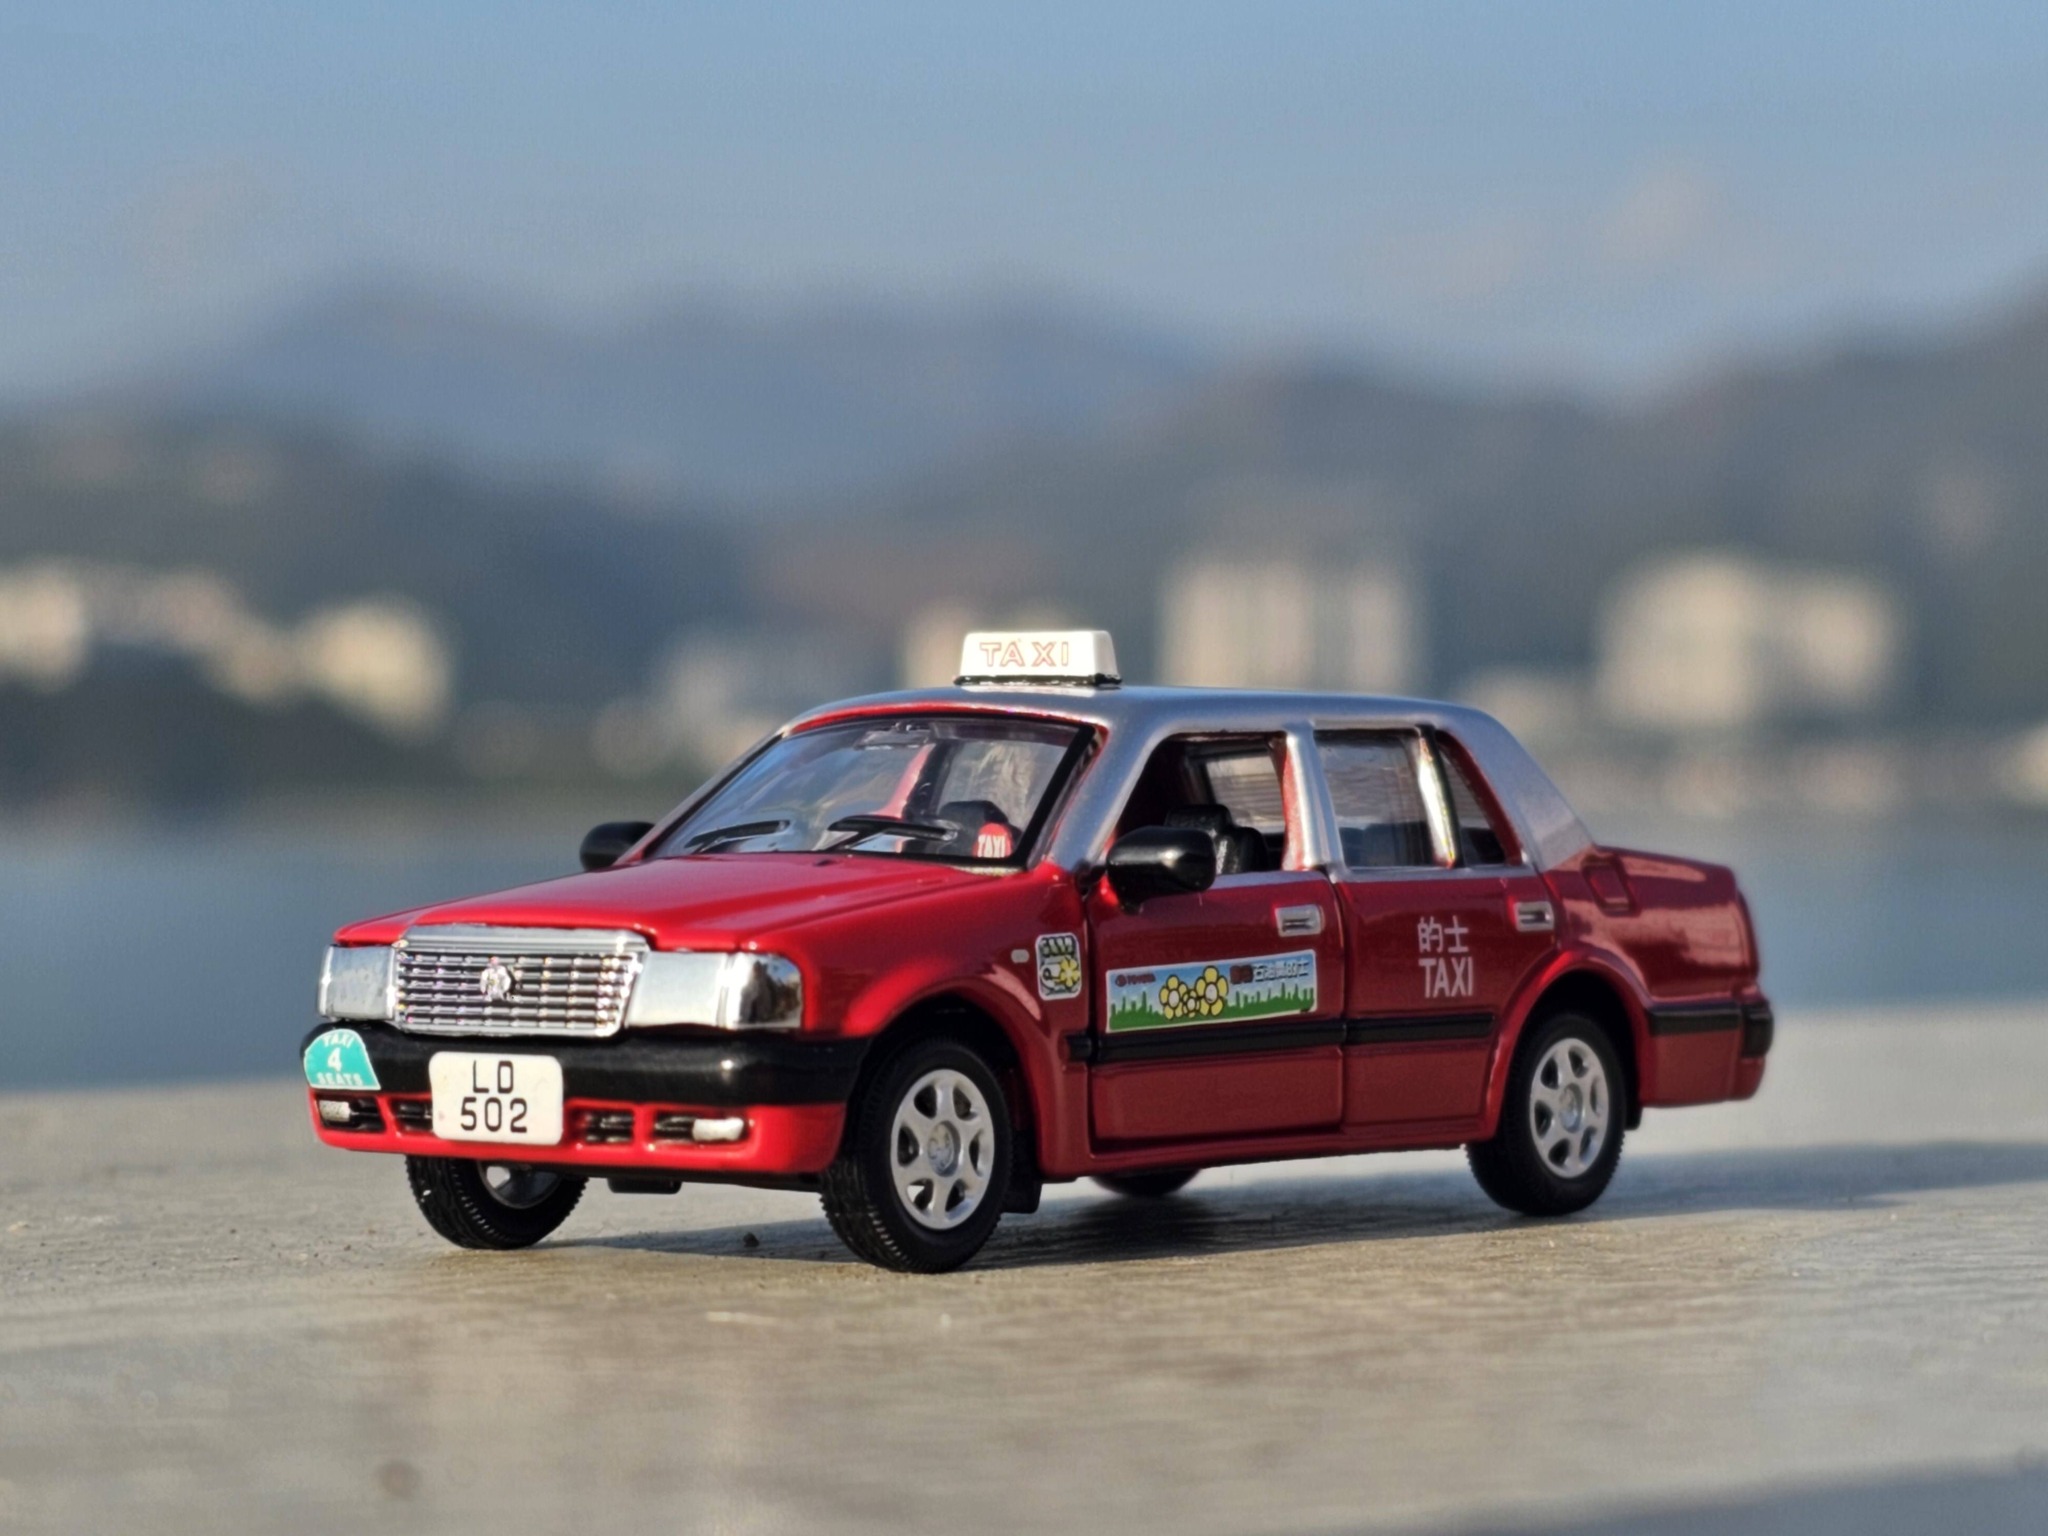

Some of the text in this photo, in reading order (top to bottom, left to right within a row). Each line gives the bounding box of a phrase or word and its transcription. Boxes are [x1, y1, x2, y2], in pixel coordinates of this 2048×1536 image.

[979, 640, 1069, 667] TAXI
[977, 834, 1006, 858] TAXI
[1417, 915, 1469, 954] 的士
[1418, 956, 1473, 998] TAXI
[321, 1032, 356, 1049] TAXI
[327, 1046, 343, 1073] 4
[316, 1072, 364, 1087] SEATS
[472, 1059, 515, 1095] LD
[460, 1096, 529, 1134] 502
